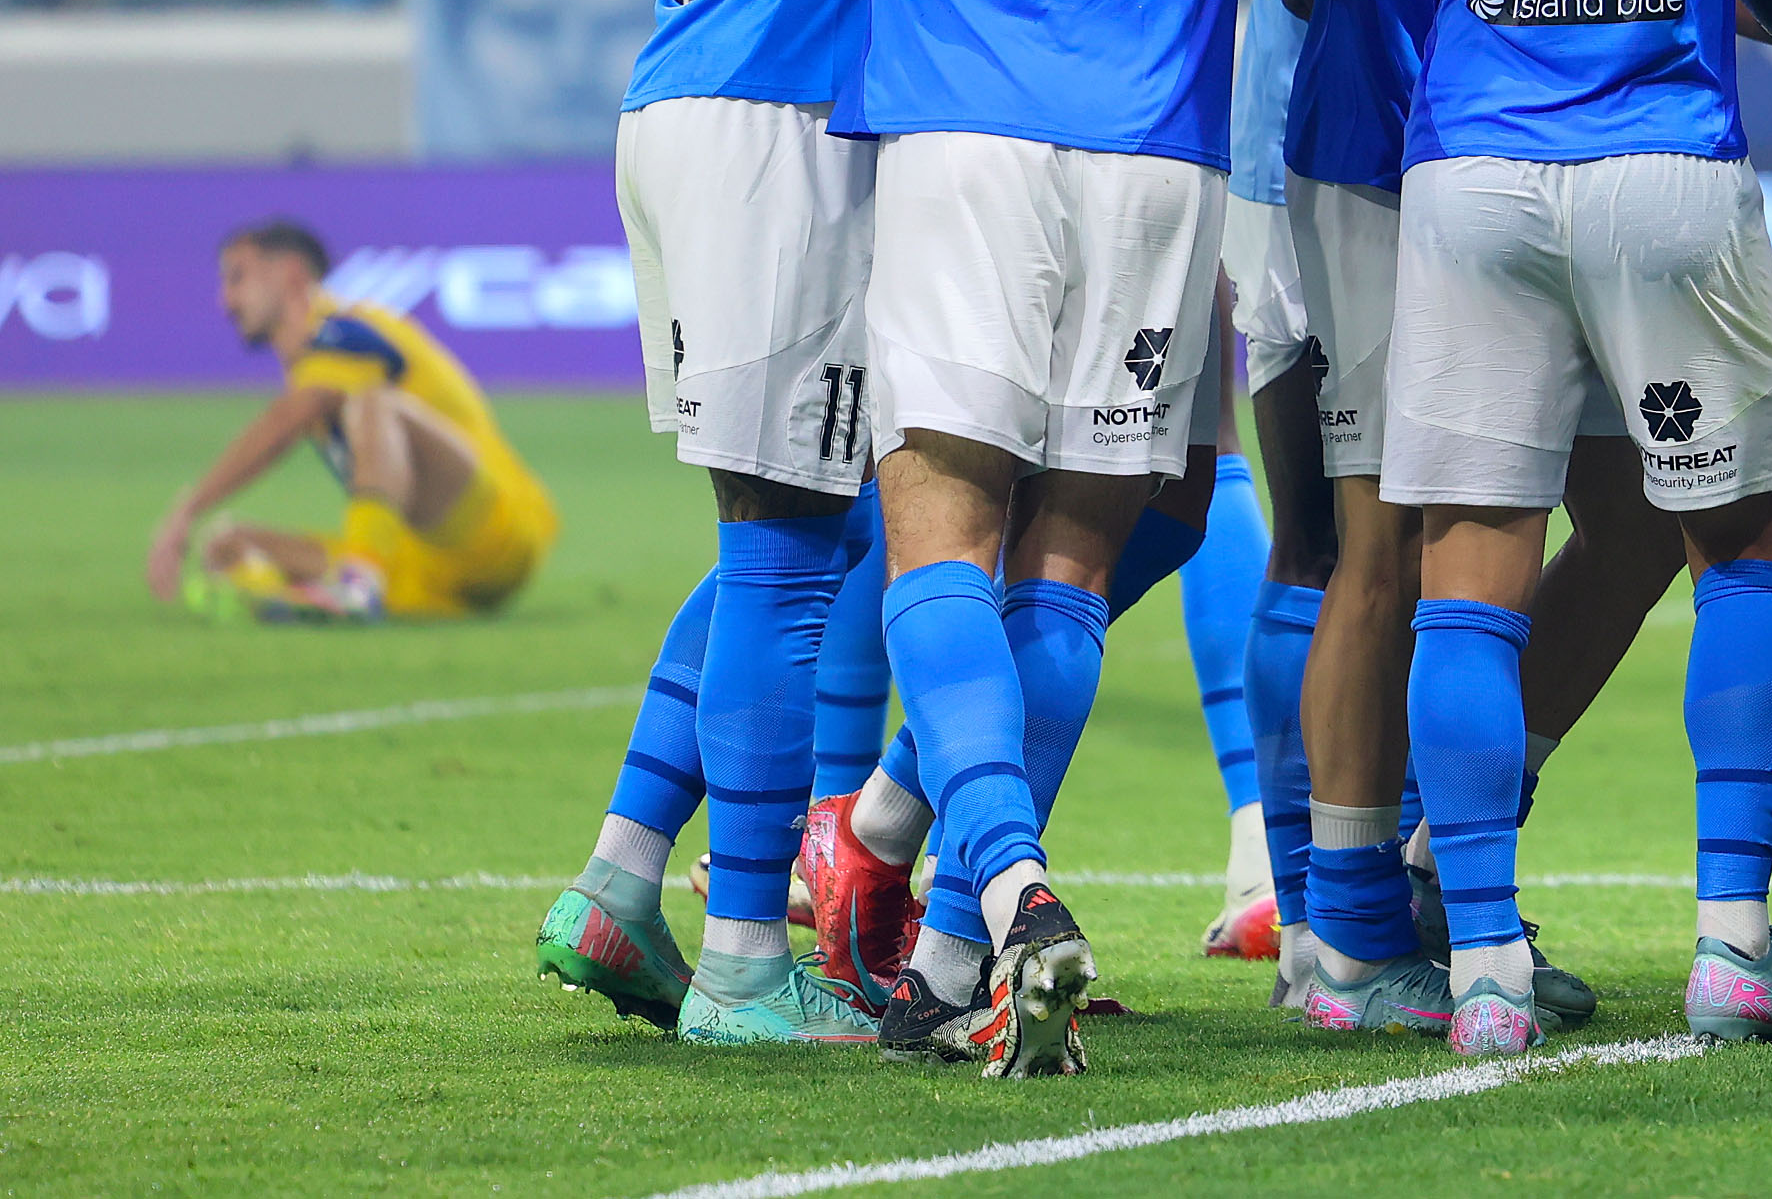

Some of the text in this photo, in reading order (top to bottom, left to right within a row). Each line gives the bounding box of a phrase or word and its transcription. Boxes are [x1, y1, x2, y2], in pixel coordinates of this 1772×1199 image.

[819, 363, 866, 463] 11
[1697, 469, 1738, 485] Partner
[576, 906, 645, 981] NIKE
